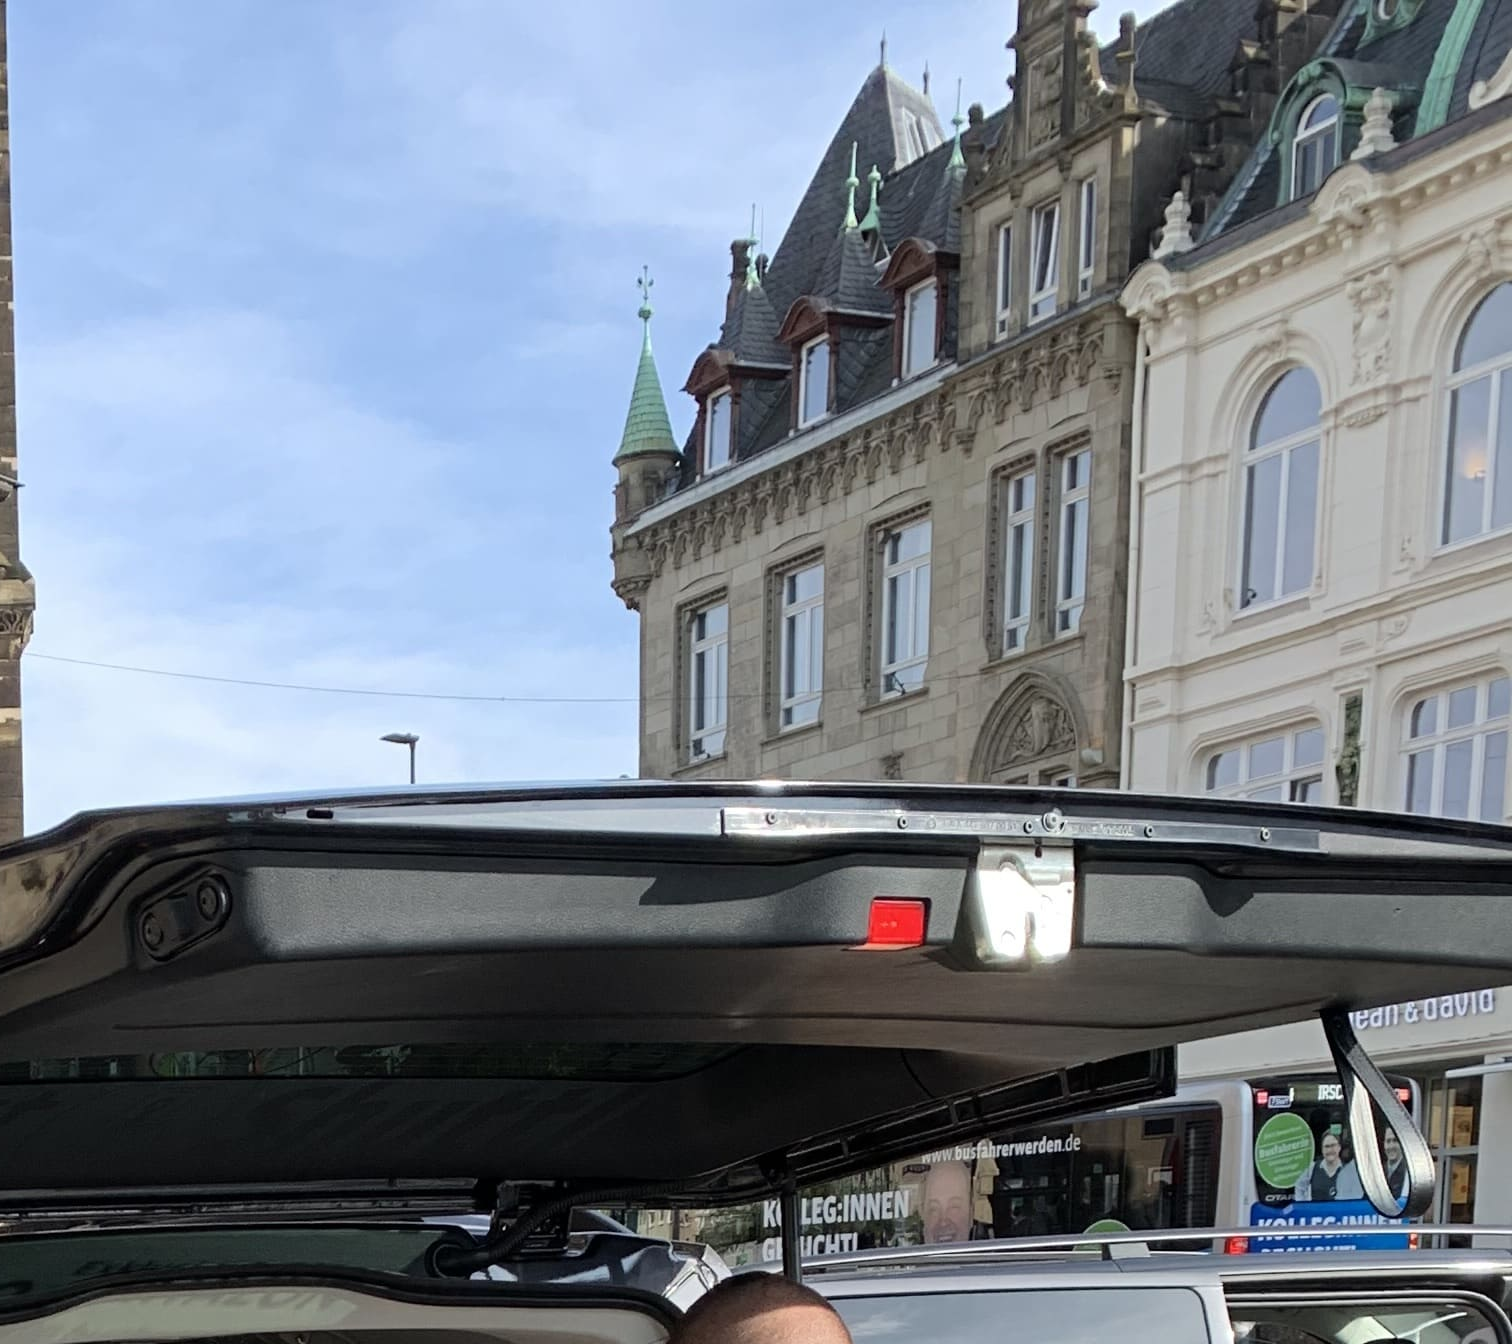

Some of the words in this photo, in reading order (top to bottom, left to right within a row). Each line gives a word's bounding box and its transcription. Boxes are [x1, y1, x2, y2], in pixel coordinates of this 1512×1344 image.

[1348, 1004, 1399, 1030] ean
[1405, 1002, 1420, 1024] &
[1424, 989, 1495, 1021] david
[1317, 1084, 1345, 1101] IRSC
[920, 1133, 1082, 1165] www.busfahrerwerden.de
[763, 1190, 909, 1228] KLEG:INNEN
